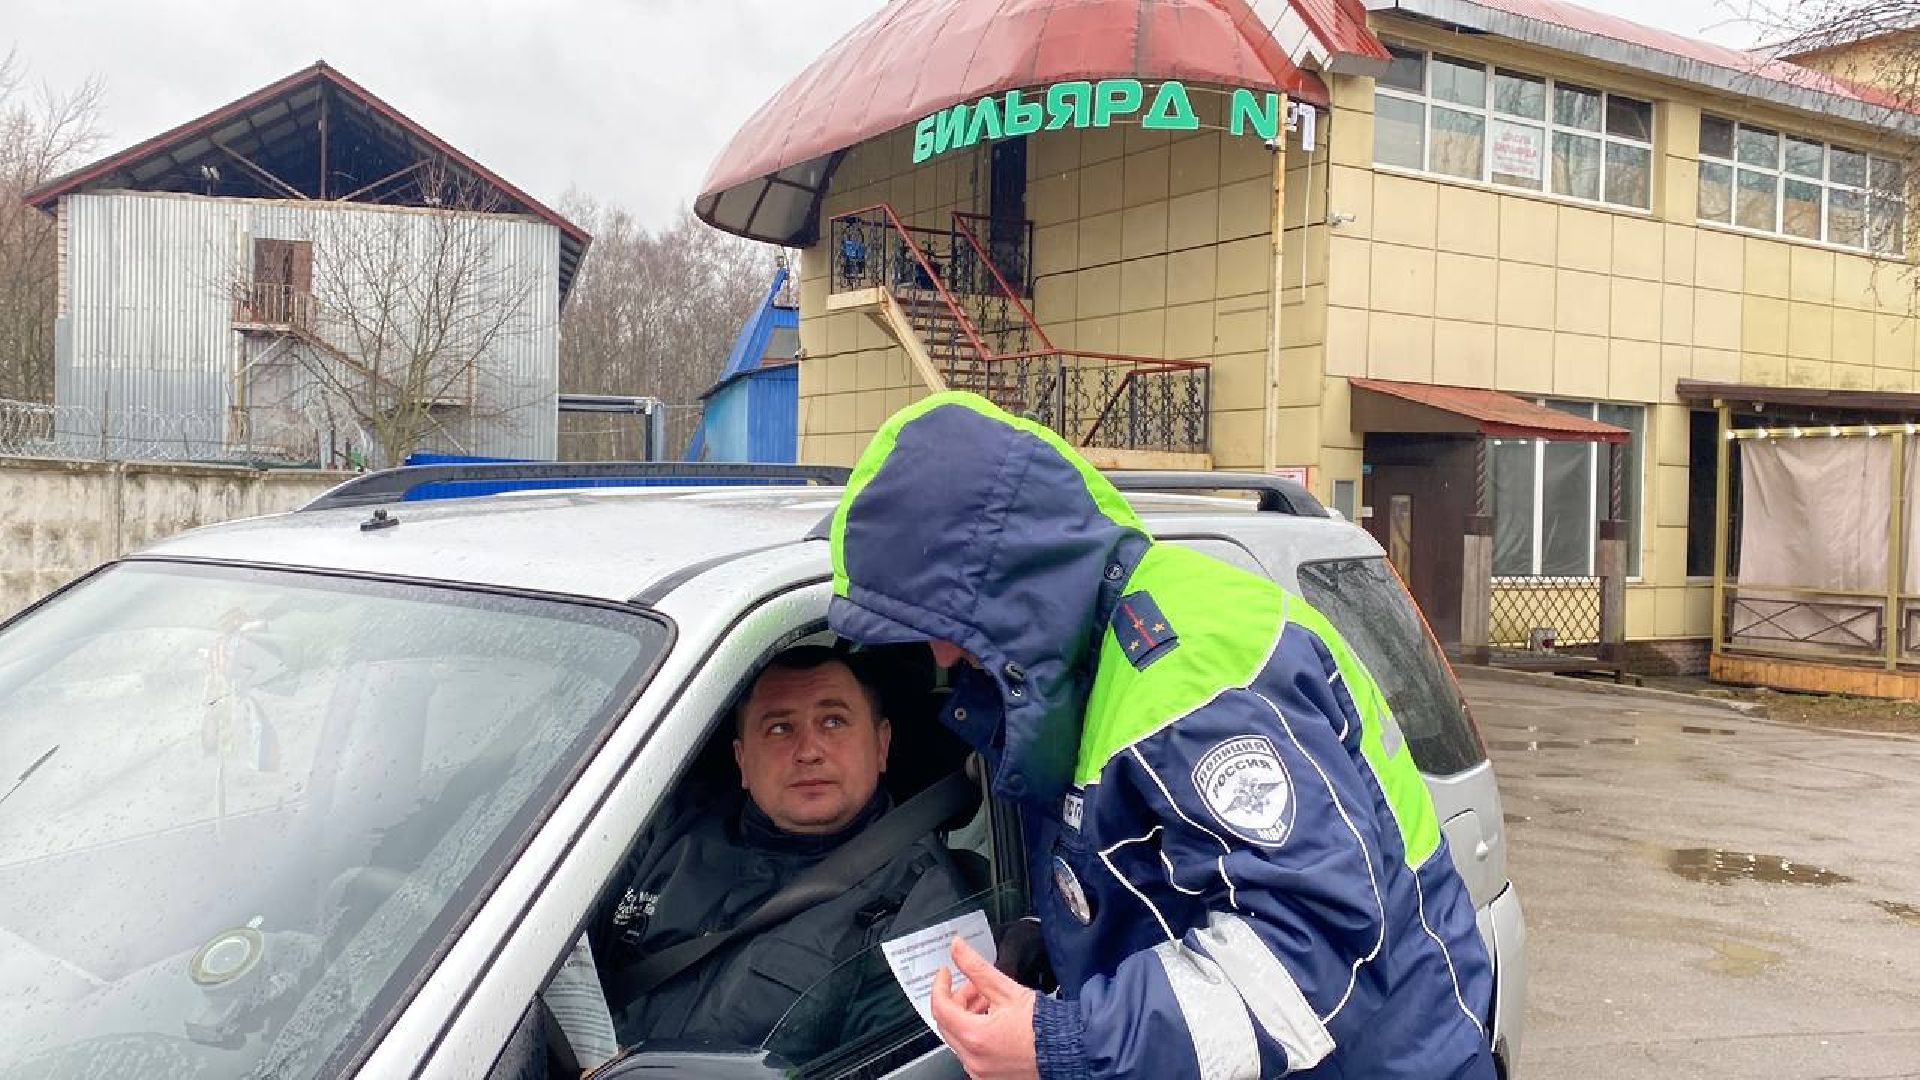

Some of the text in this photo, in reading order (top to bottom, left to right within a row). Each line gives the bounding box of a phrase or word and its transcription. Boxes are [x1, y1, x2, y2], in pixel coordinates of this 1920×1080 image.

[912, 79, 1199, 164] БИЛЬЯРД
[1199, 741, 1268, 785] ПОЛИЦИЯ
[1212, 758, 1273, 799] РОССИЯ
